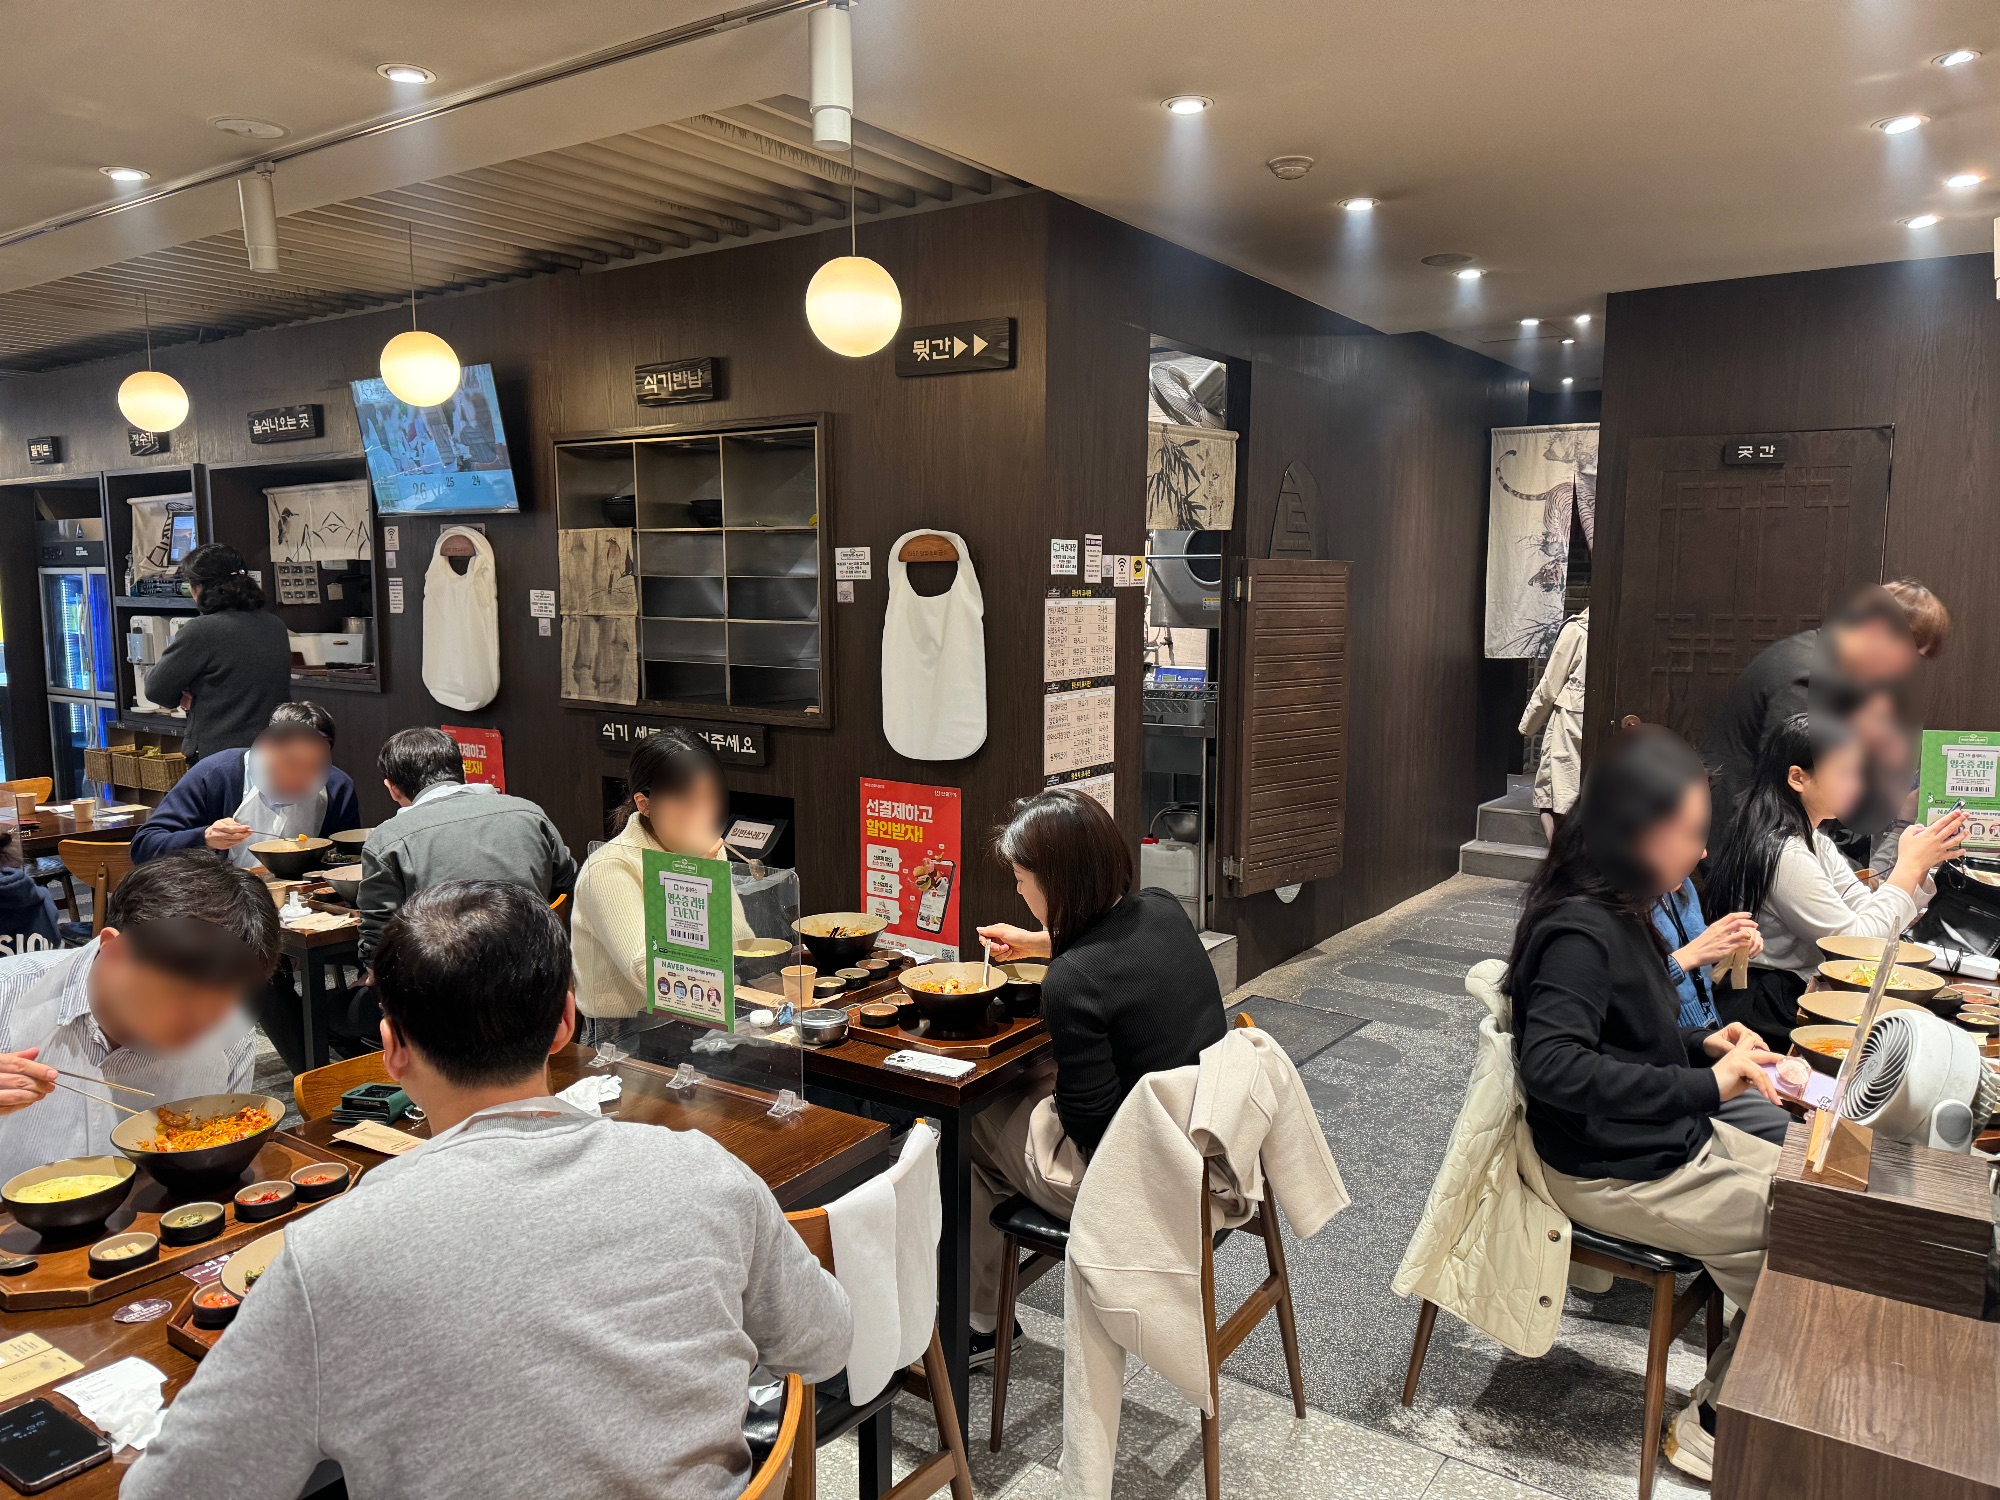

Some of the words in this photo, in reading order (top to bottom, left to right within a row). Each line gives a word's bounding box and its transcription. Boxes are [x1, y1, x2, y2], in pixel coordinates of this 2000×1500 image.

[912, 337, 951, 361] 뒷간
[643, 368, 703, 394] 식기반납
[252, 415, 297, 434] 음식나오는
[298, 413, 309, 428] 곳
[445, 476, 455, 488] 25
[471, 475, 481, 486] 24
[412, 482, 427, 500] 26
[602, 723, 629, 742] 식기
[458, 743, 487, 759] 제하고
[1950, 759, 1975, 769] 영수증
[1977, 760, 1994, 769] 리뷰
[1955, 769, 1987, 778] EVENT
[866, 798, 933, 823] 선결제하고
[731, 828, 768, 841] 일반쓰레기
[865, 818, 924, 843] 할인받자!
[667, 892, 690, 907] 영수증
[690, 896, 705, 910] 리뷰
[673, 906, 700, 920] EVENT
[661, 961, 685, 971] NAVER
